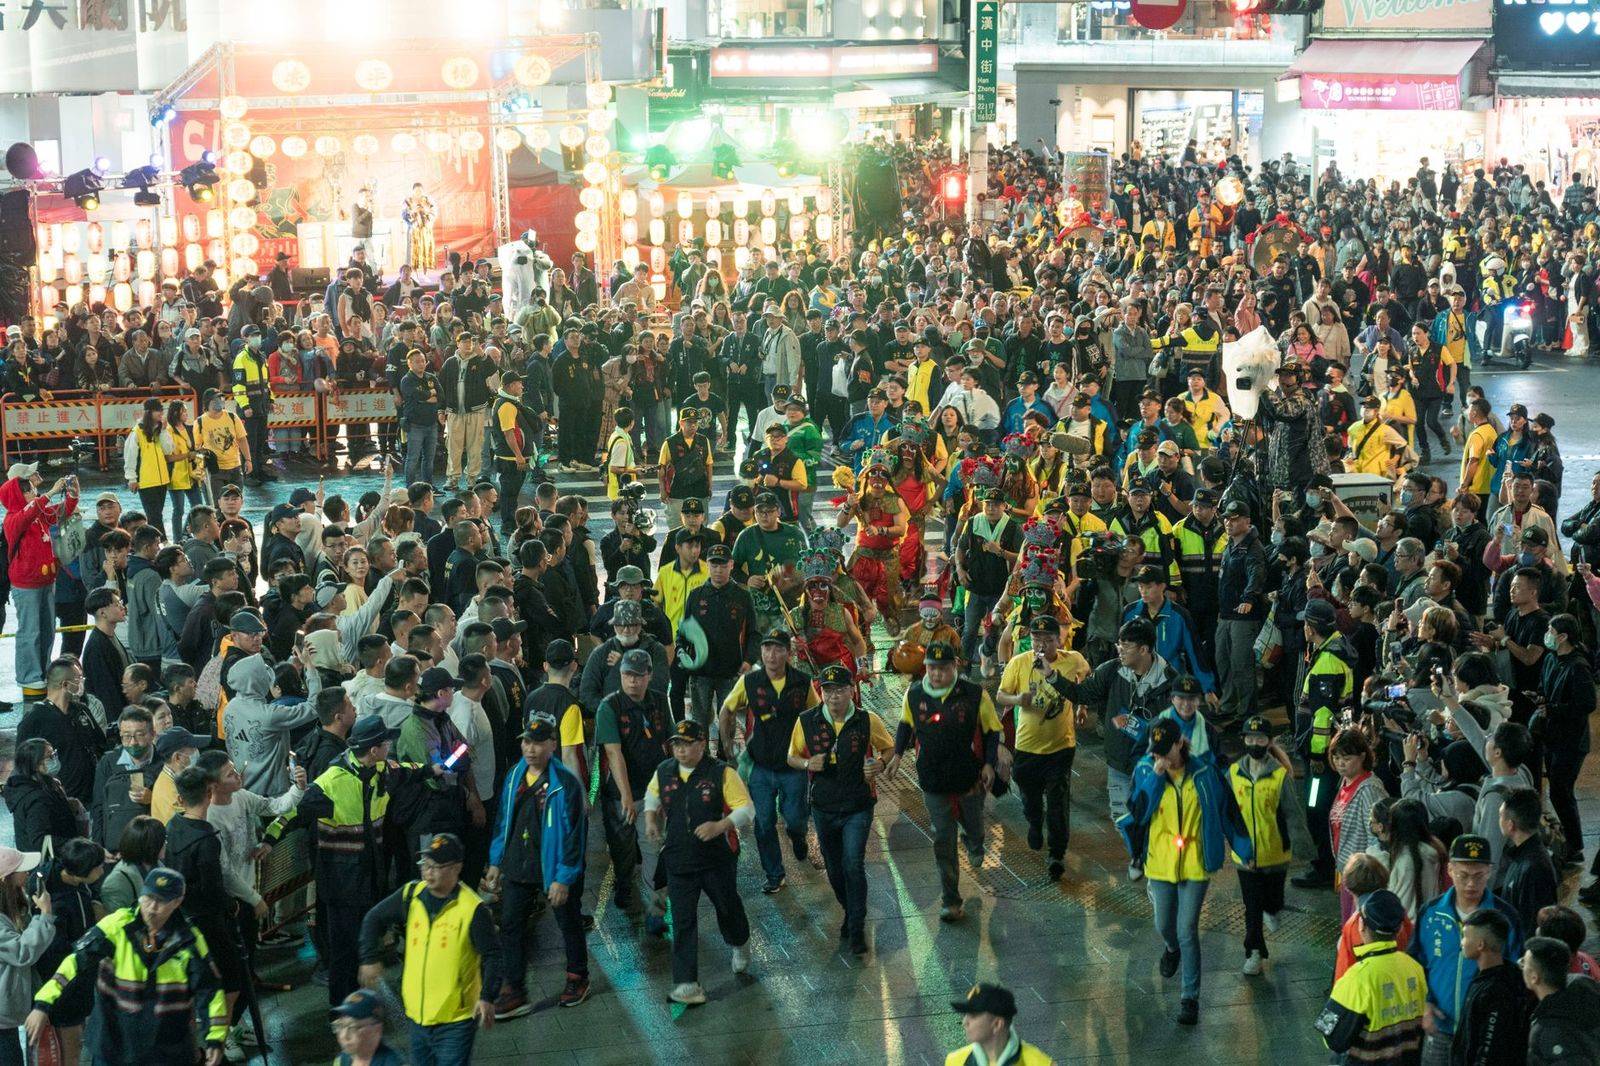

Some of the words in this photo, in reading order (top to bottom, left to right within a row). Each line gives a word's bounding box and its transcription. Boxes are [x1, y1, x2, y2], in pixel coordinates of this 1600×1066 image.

[981, 16, 993, 74] 漢中街
[16, 409, 90, 424] 禁止進入
